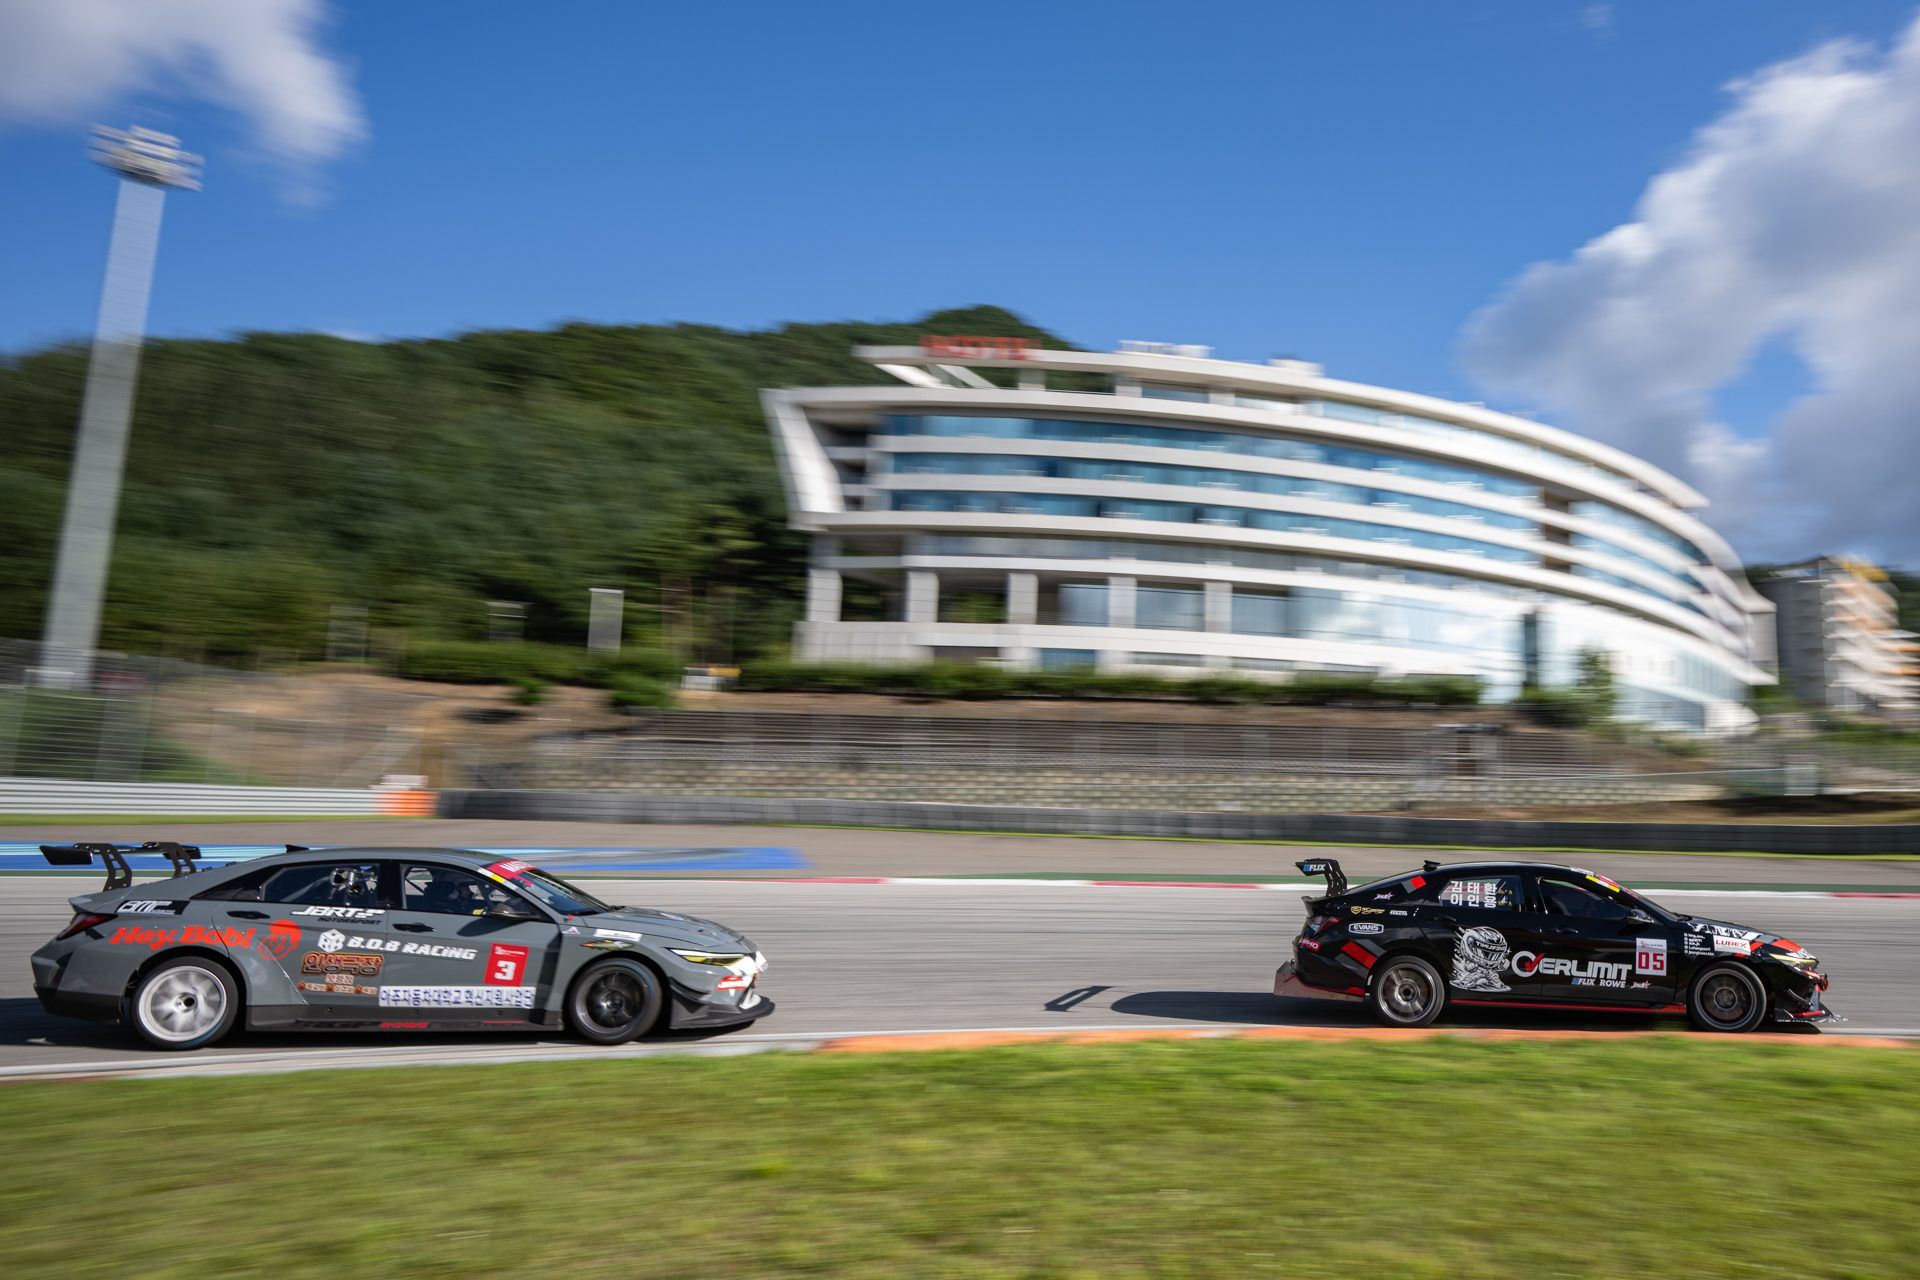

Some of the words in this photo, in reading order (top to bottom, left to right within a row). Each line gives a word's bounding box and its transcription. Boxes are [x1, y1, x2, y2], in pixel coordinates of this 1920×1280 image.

[1308, 864, 1326, 872] FLIX
[178, 925, 257, 949] Bob!
[346, 936, 402, 953] B.O.B
[402, 942, 478, 961] RACING
[302, 952, 385, 975] 인생극장
[493, 960, 517, 981] 3
[1638, 951, 1665, 971] 05
[1577, 978, 1596, 987] FLIX
[1599, 979, 1627, 989] ROWE
